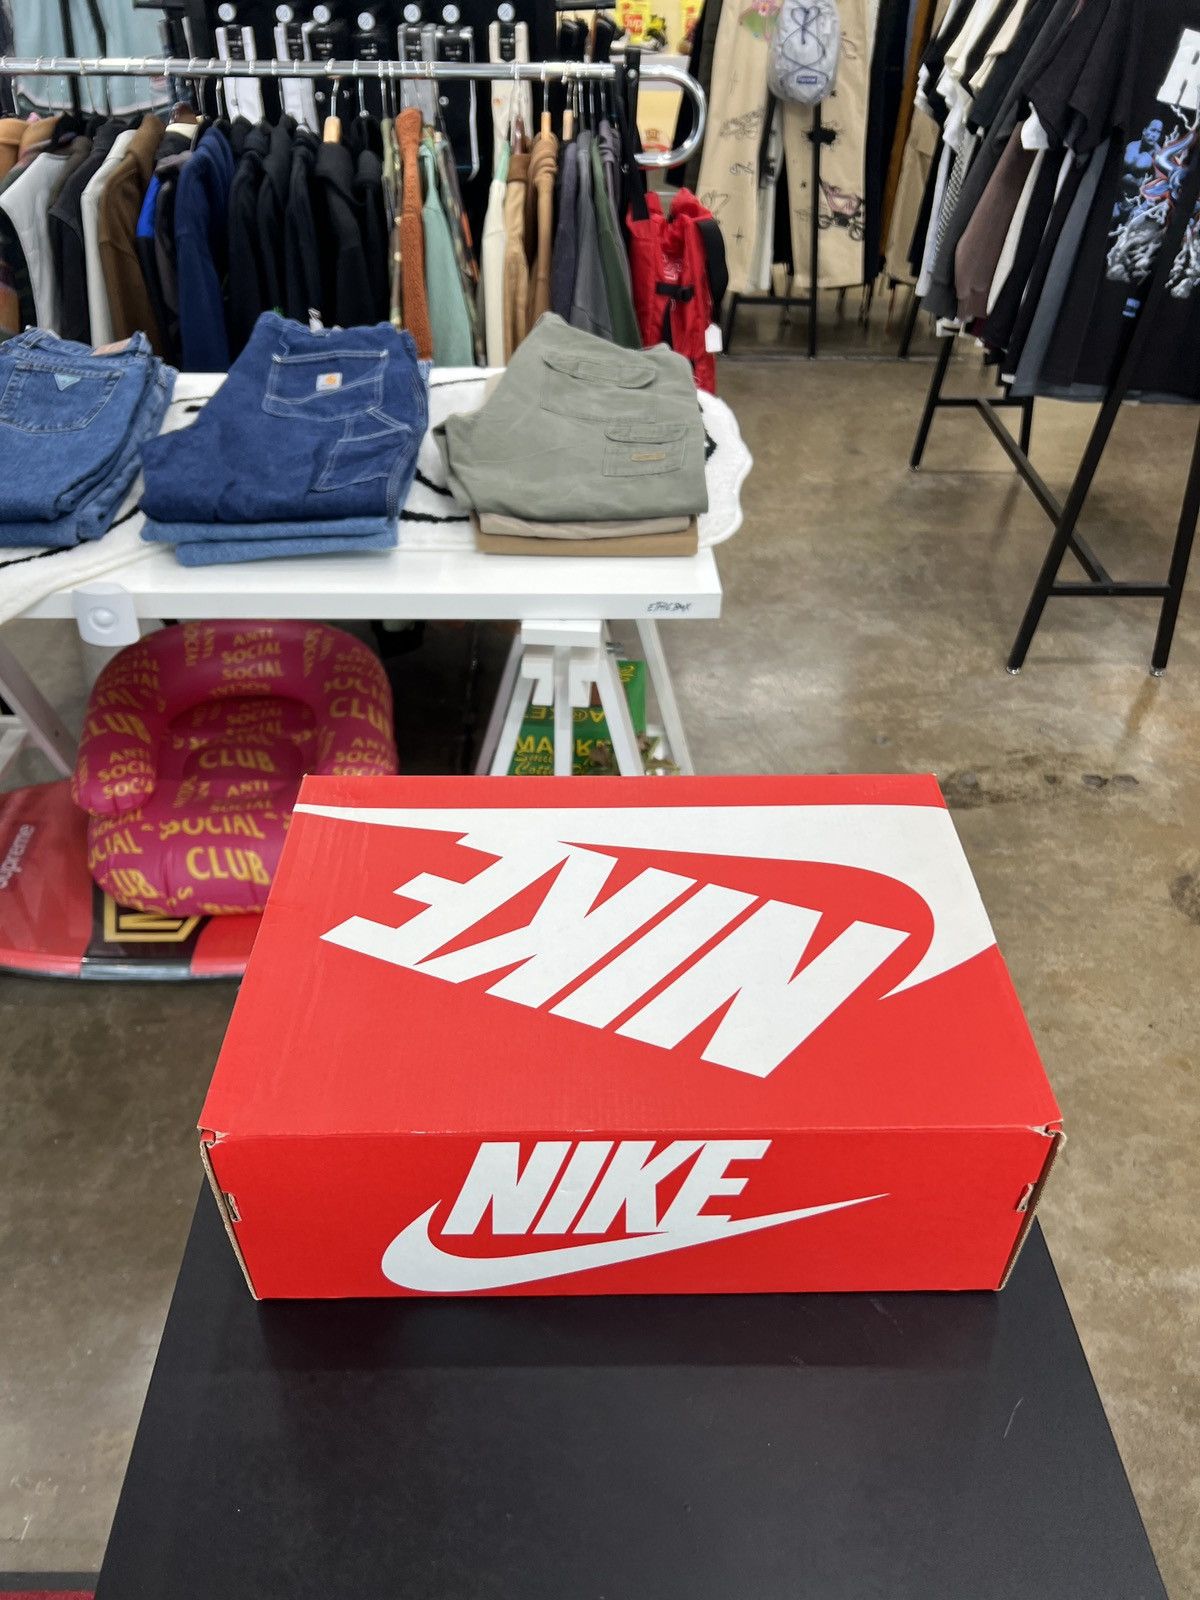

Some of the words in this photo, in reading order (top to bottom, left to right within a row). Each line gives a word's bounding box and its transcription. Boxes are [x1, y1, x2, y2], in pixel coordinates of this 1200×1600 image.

[233, 627, 275, 646] ANTI
[222, 641, 281, 665] SOCIAL
[222, 661, 284, 681] SOCIAL
[198, 749, 277, 774] CLUB
[227, 781, 270, 799] ANTI
[185, 846, 271, 886] CLUB
[319, 832, 912, 1078] NIKE
[441, 1139, 772, 1236] NIKE
